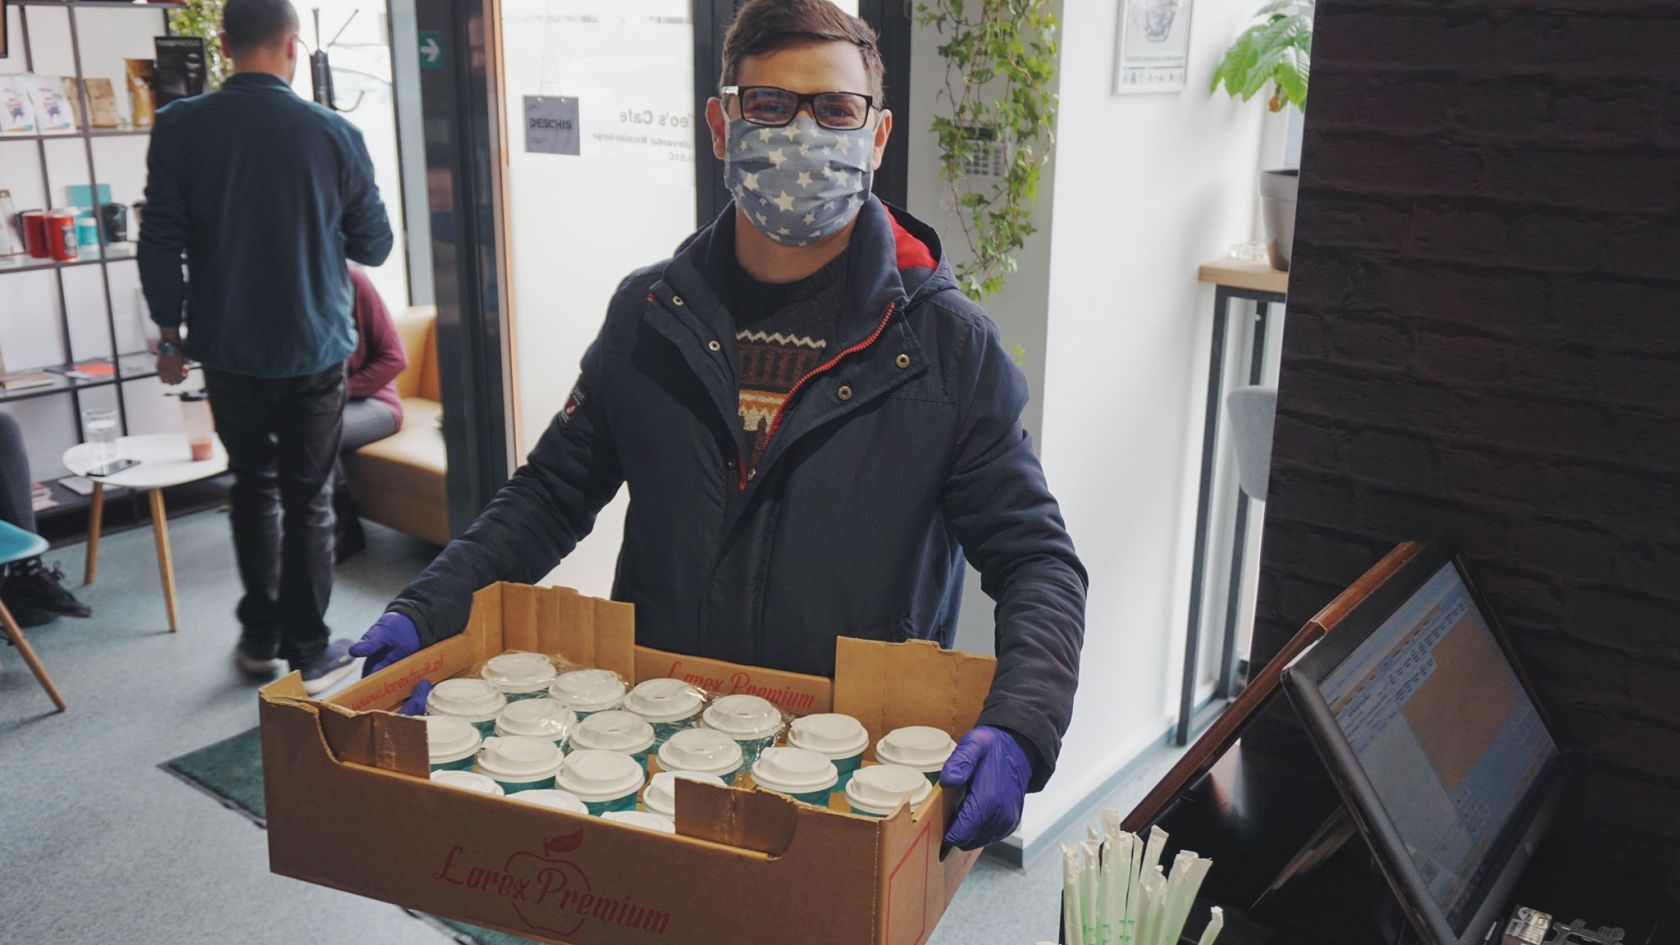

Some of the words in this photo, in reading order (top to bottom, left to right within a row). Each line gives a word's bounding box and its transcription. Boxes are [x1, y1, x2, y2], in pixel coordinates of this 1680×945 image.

[529, 117, 573, 131] DESCHIS
[666, 660, 724, 691] Larex
[729, 672, 816, 709] Premium
[433, 845, 530, 901] Larex
[534, 866, 671, 935] Premium
